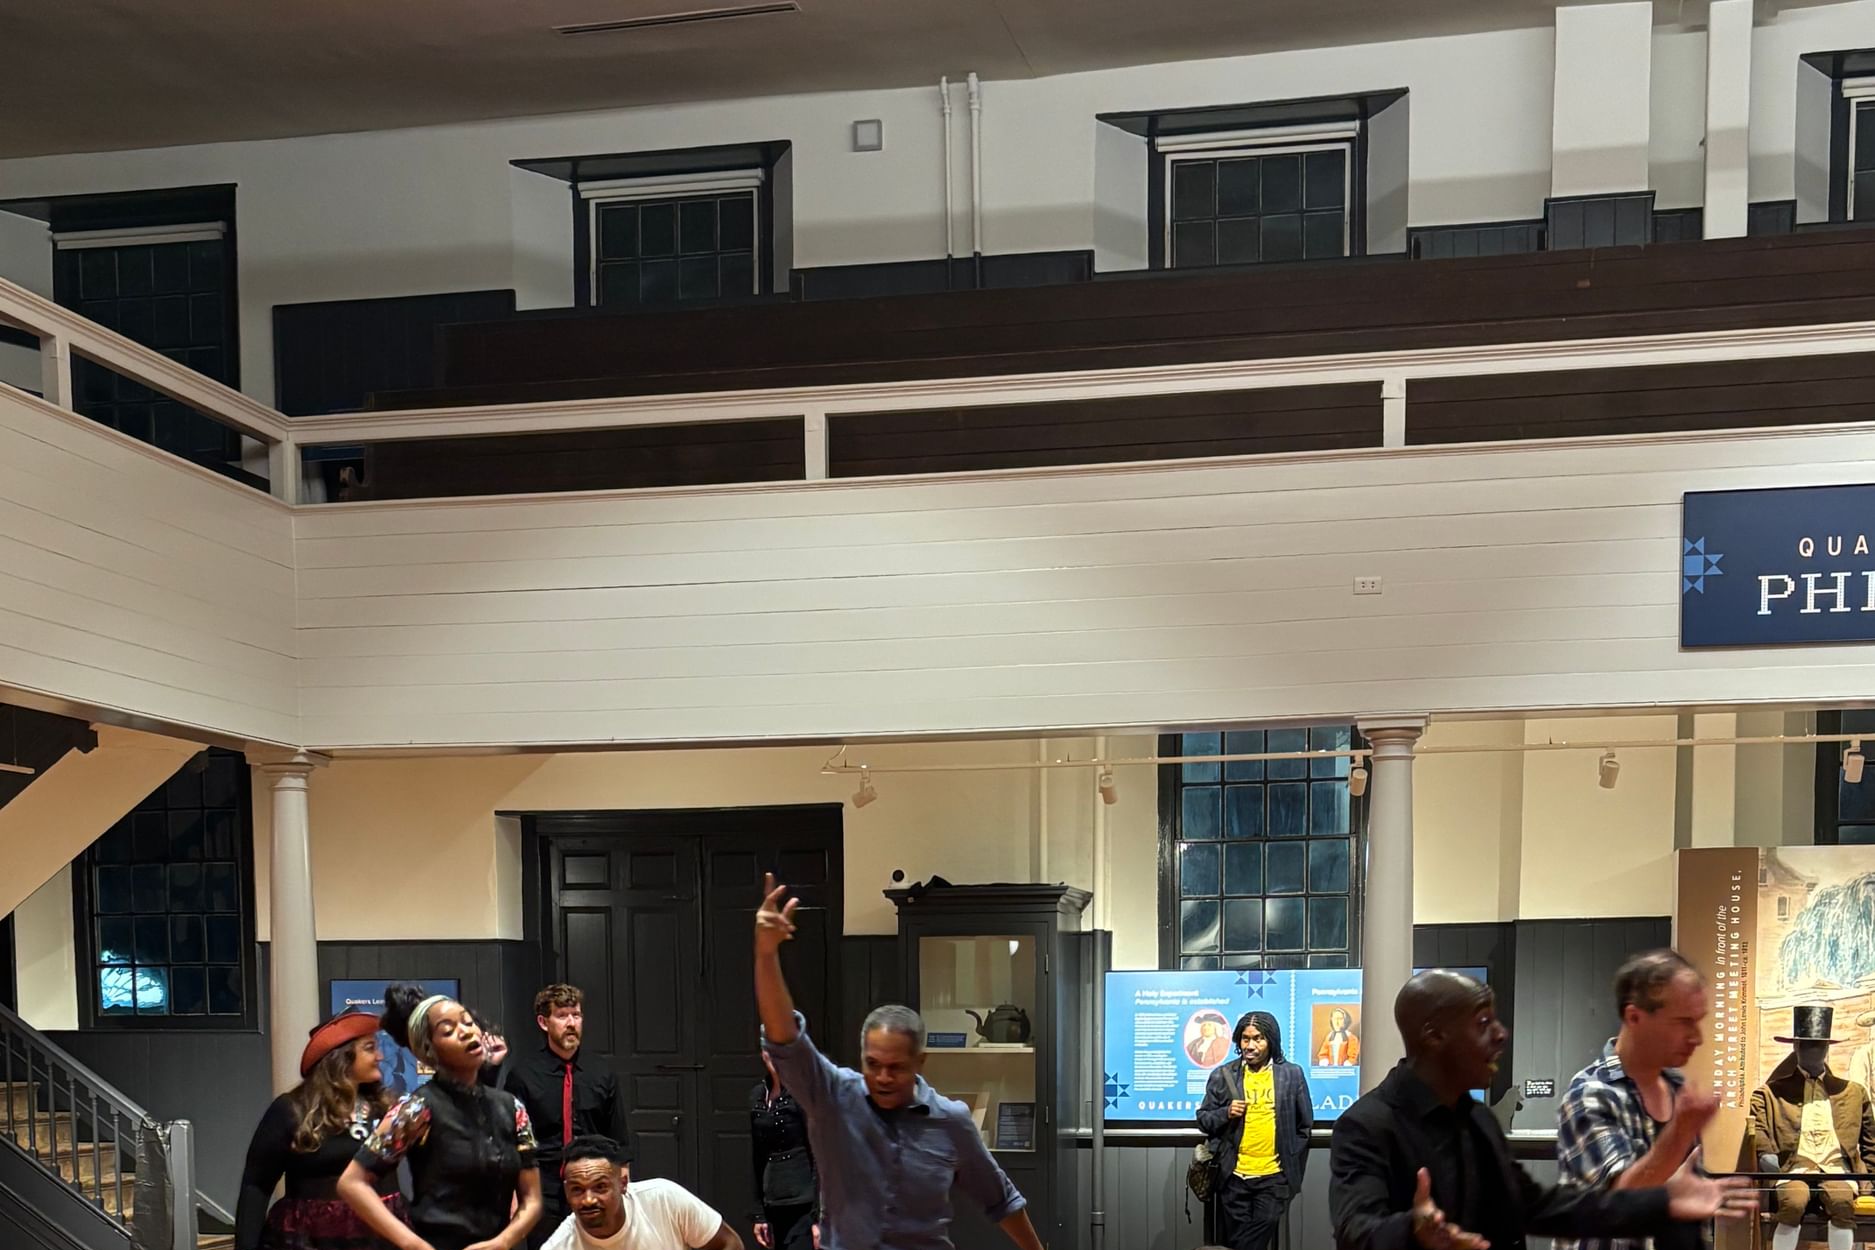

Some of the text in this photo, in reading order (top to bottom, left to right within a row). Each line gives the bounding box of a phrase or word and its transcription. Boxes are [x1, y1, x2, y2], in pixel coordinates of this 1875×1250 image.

[1799, 535, 1869, 557] QUA
[1716, 905, 1727, 920] the
[1715, 920, 1727, 932] of
[1715, 933, 1726, 955] front
[1726, 870, 1742, 1108] ARCH STREET MEETING HOUSE,
[1713, 971, 1726, 1042] MORNING
[1138, 1100, 1201, 1111] QUAKERS
